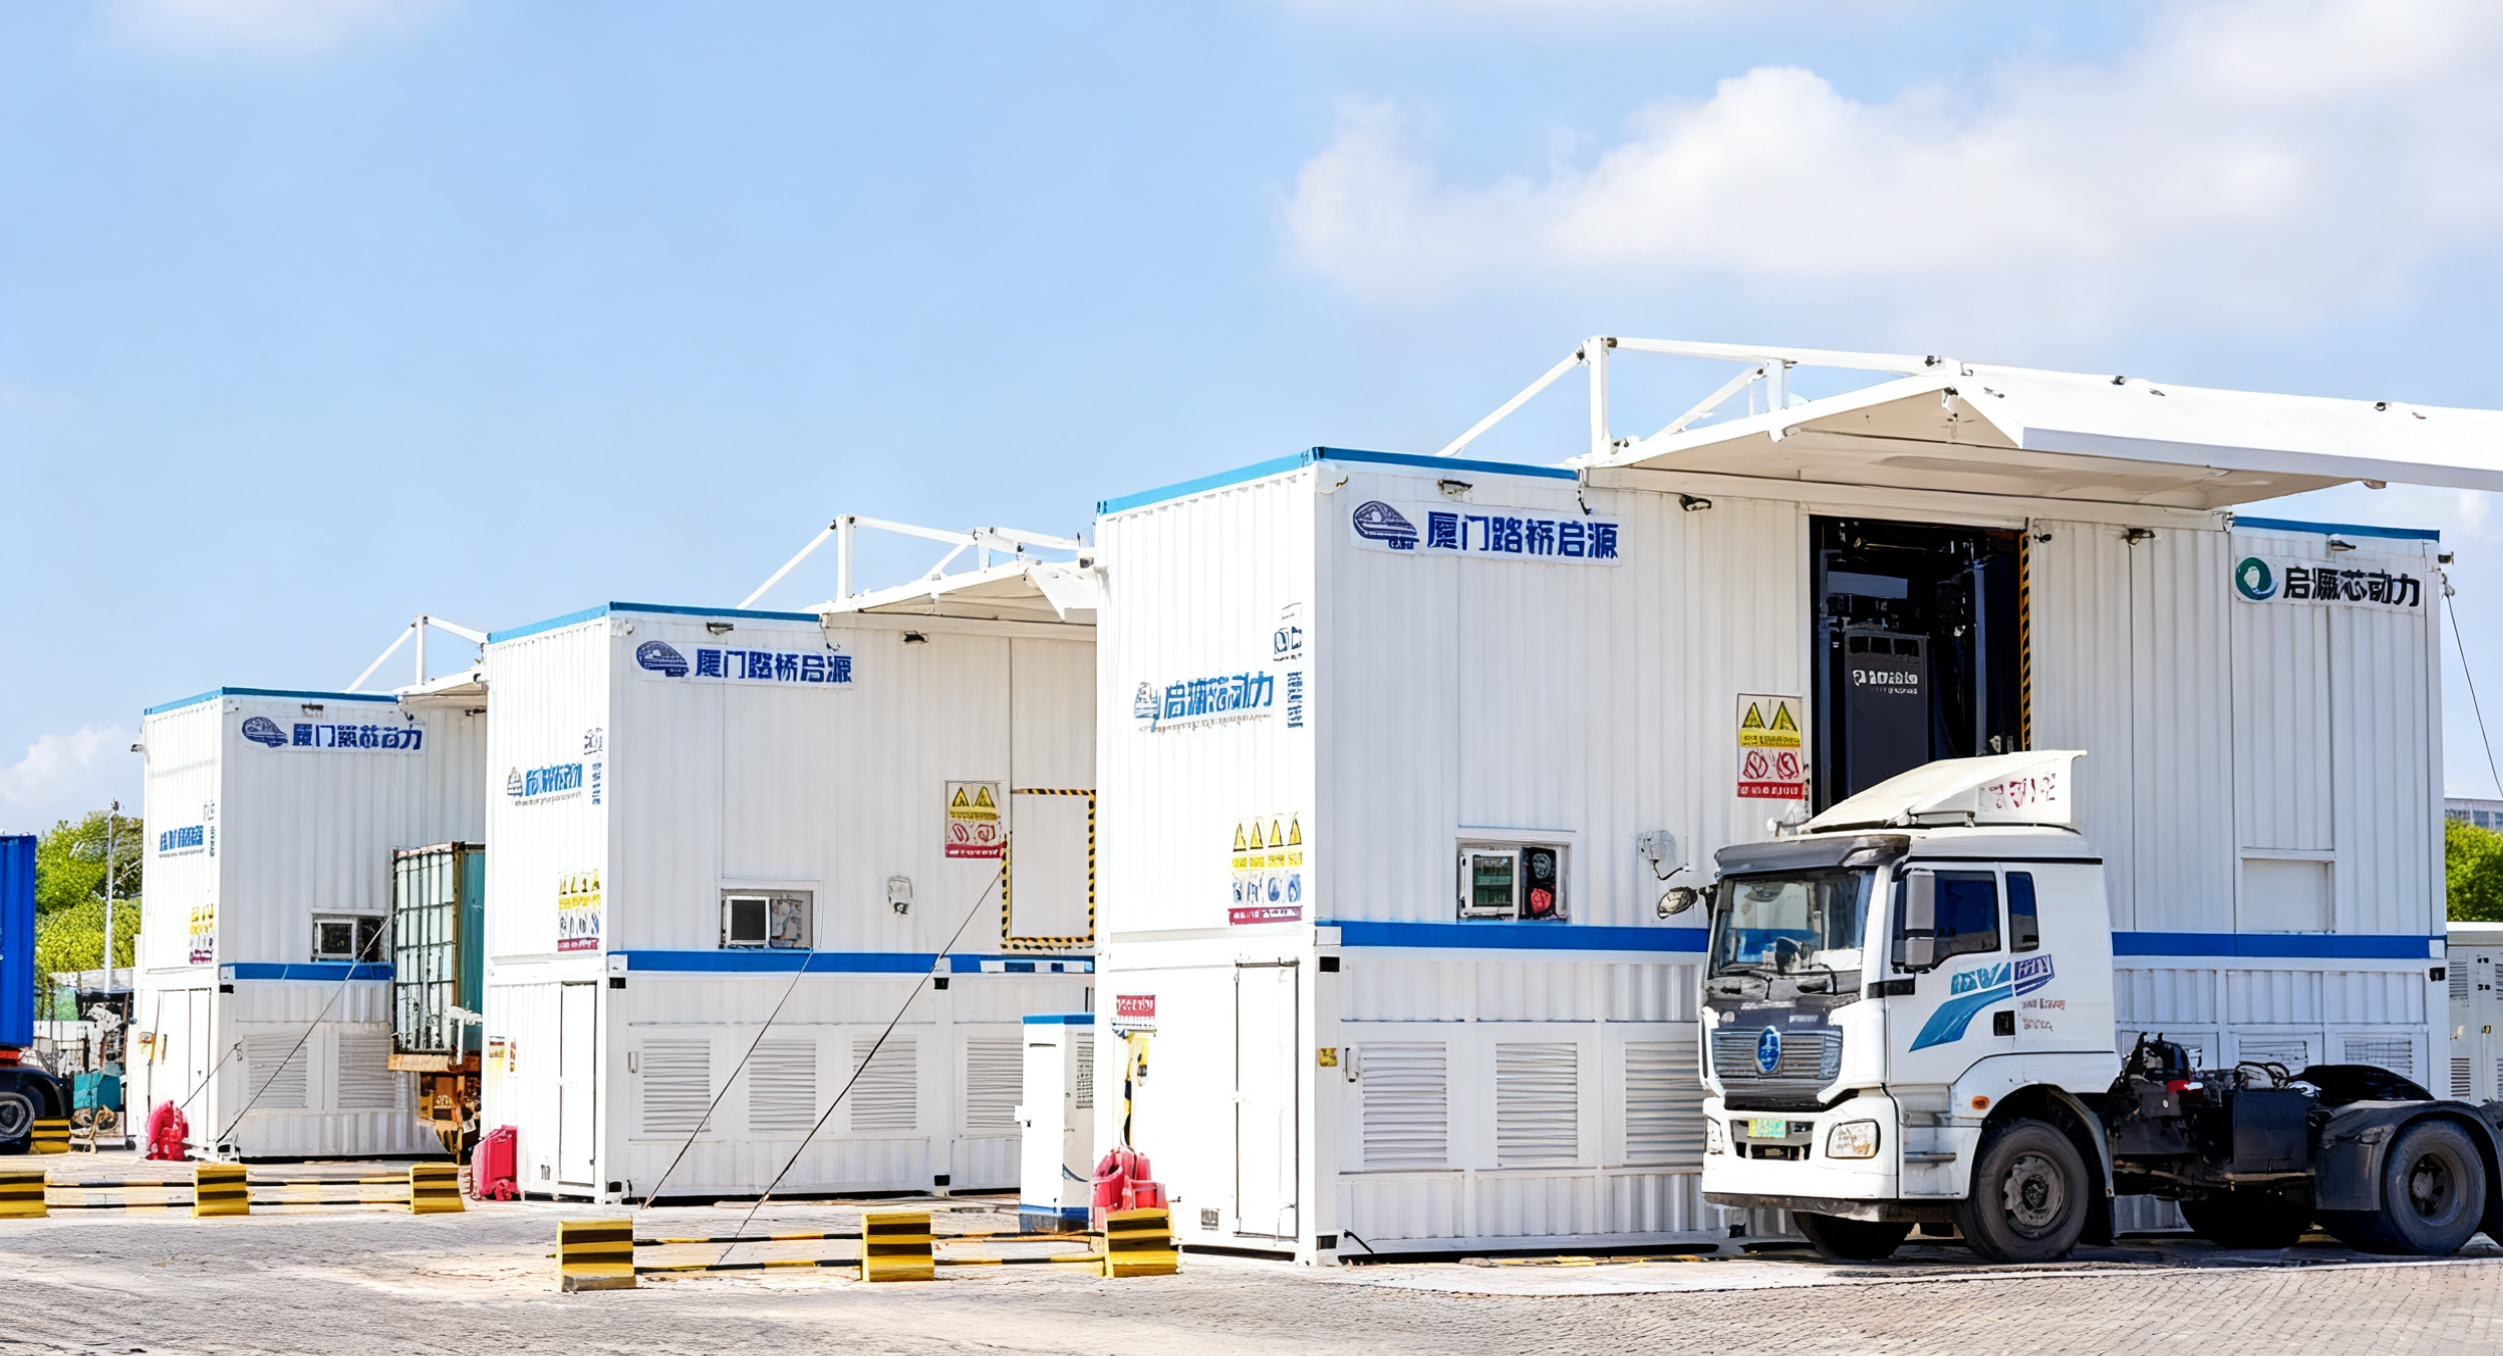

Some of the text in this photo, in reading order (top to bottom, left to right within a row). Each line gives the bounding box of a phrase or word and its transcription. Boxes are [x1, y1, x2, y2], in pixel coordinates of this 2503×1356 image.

[1427, 511, 1619, 560] 厦门路桥启源
[695, 648, 853, 684] 厦门路桥启源
